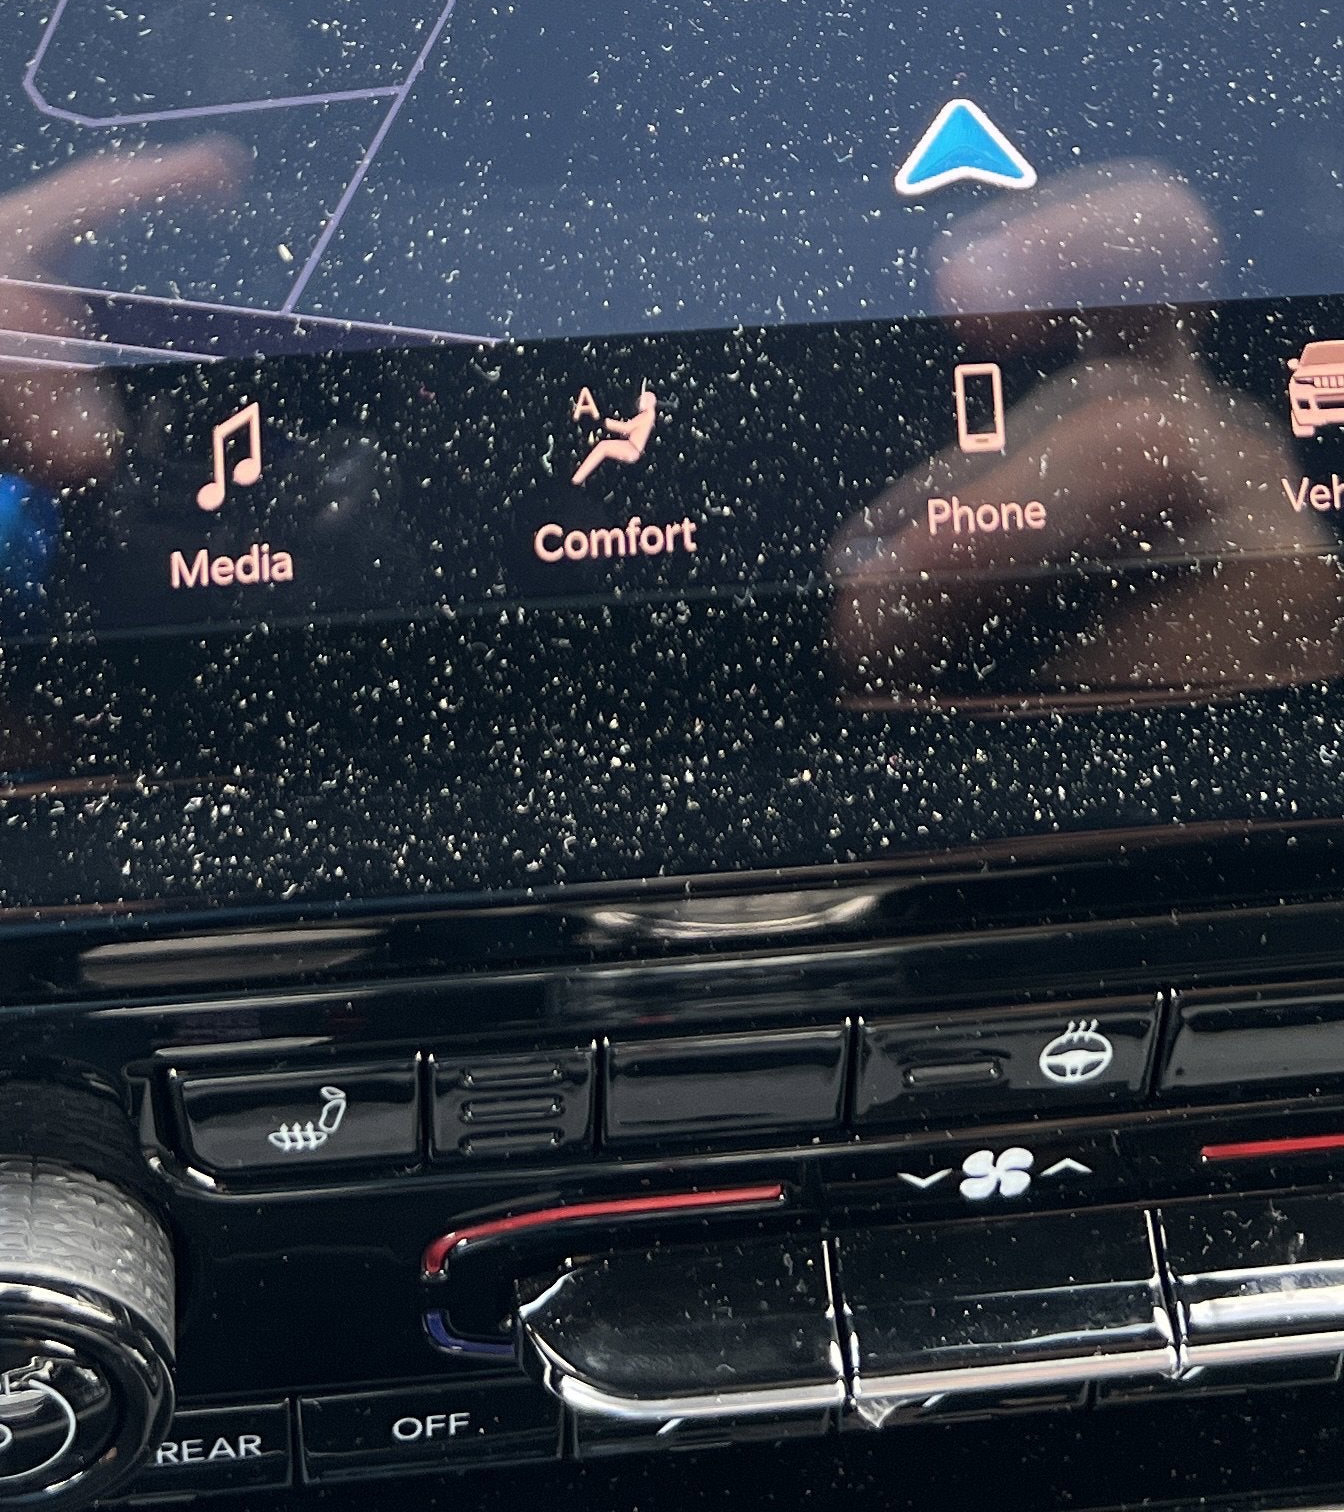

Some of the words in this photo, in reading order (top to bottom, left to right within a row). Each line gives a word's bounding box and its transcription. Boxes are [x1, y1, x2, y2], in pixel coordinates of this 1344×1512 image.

[926, 493, 1046, 533] Phone
[534, 517, 698, 563] Comfort
[171, 543, 295, 590] Media
[392, 1410, 472, 1442] OFF
[156, 1433, 263, 1465] REAR
